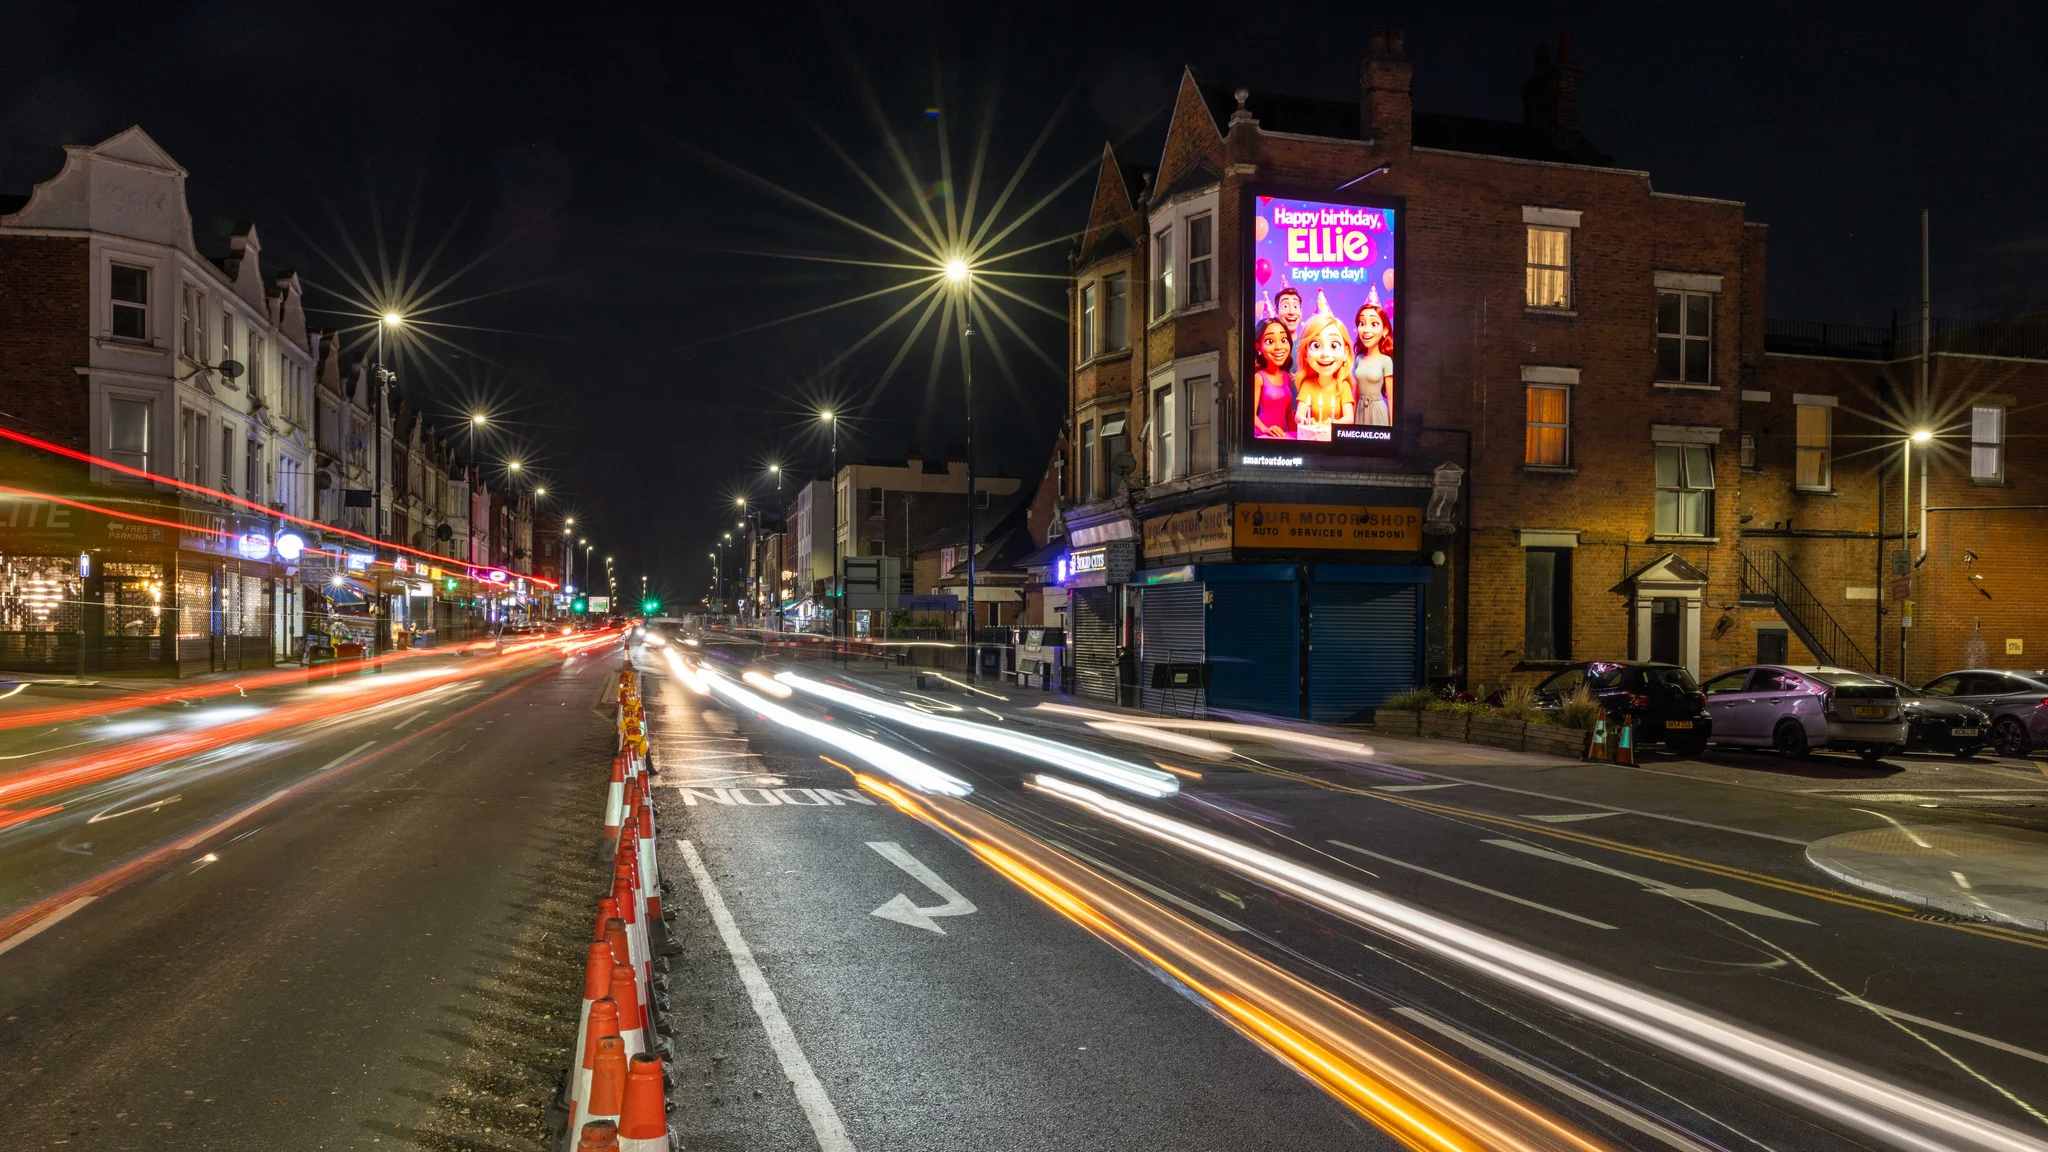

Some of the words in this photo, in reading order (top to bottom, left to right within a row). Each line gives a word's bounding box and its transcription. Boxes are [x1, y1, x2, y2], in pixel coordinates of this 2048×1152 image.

[1274, 207, 1320, 229] Happy
[1321, 208, 1382, 229] birthday,
[1292, 267, 1320, 282] Enjoy
[1321, 267, 1341, 279] the
[1340, 267, 1365, 282] day!
[1337, 430, 1391, 440] FAMECAKE.COM
[0, 498, 71, 529] ITE
[1240, 511, 1290, 525] YOUR
[1300, 512, 1360, 526] MOTOR
[1369, 514, 1417, 527] SHOP
[125, 525, 149, 534] FREE
[1172, 516, 1200, 536] MOTOR
[109, 531, 149, 542] PARKING
[152, 529, 161, 539] P
[1253, 528, 1279, 537] AUTO
[1290, 528, 1343, 538] SERVICES
[1353, 530, 1405, 540] (HENDON)
[1076, 555, 1091, 571] SOLID
[1091, 553, 1105, 567] CUTS
